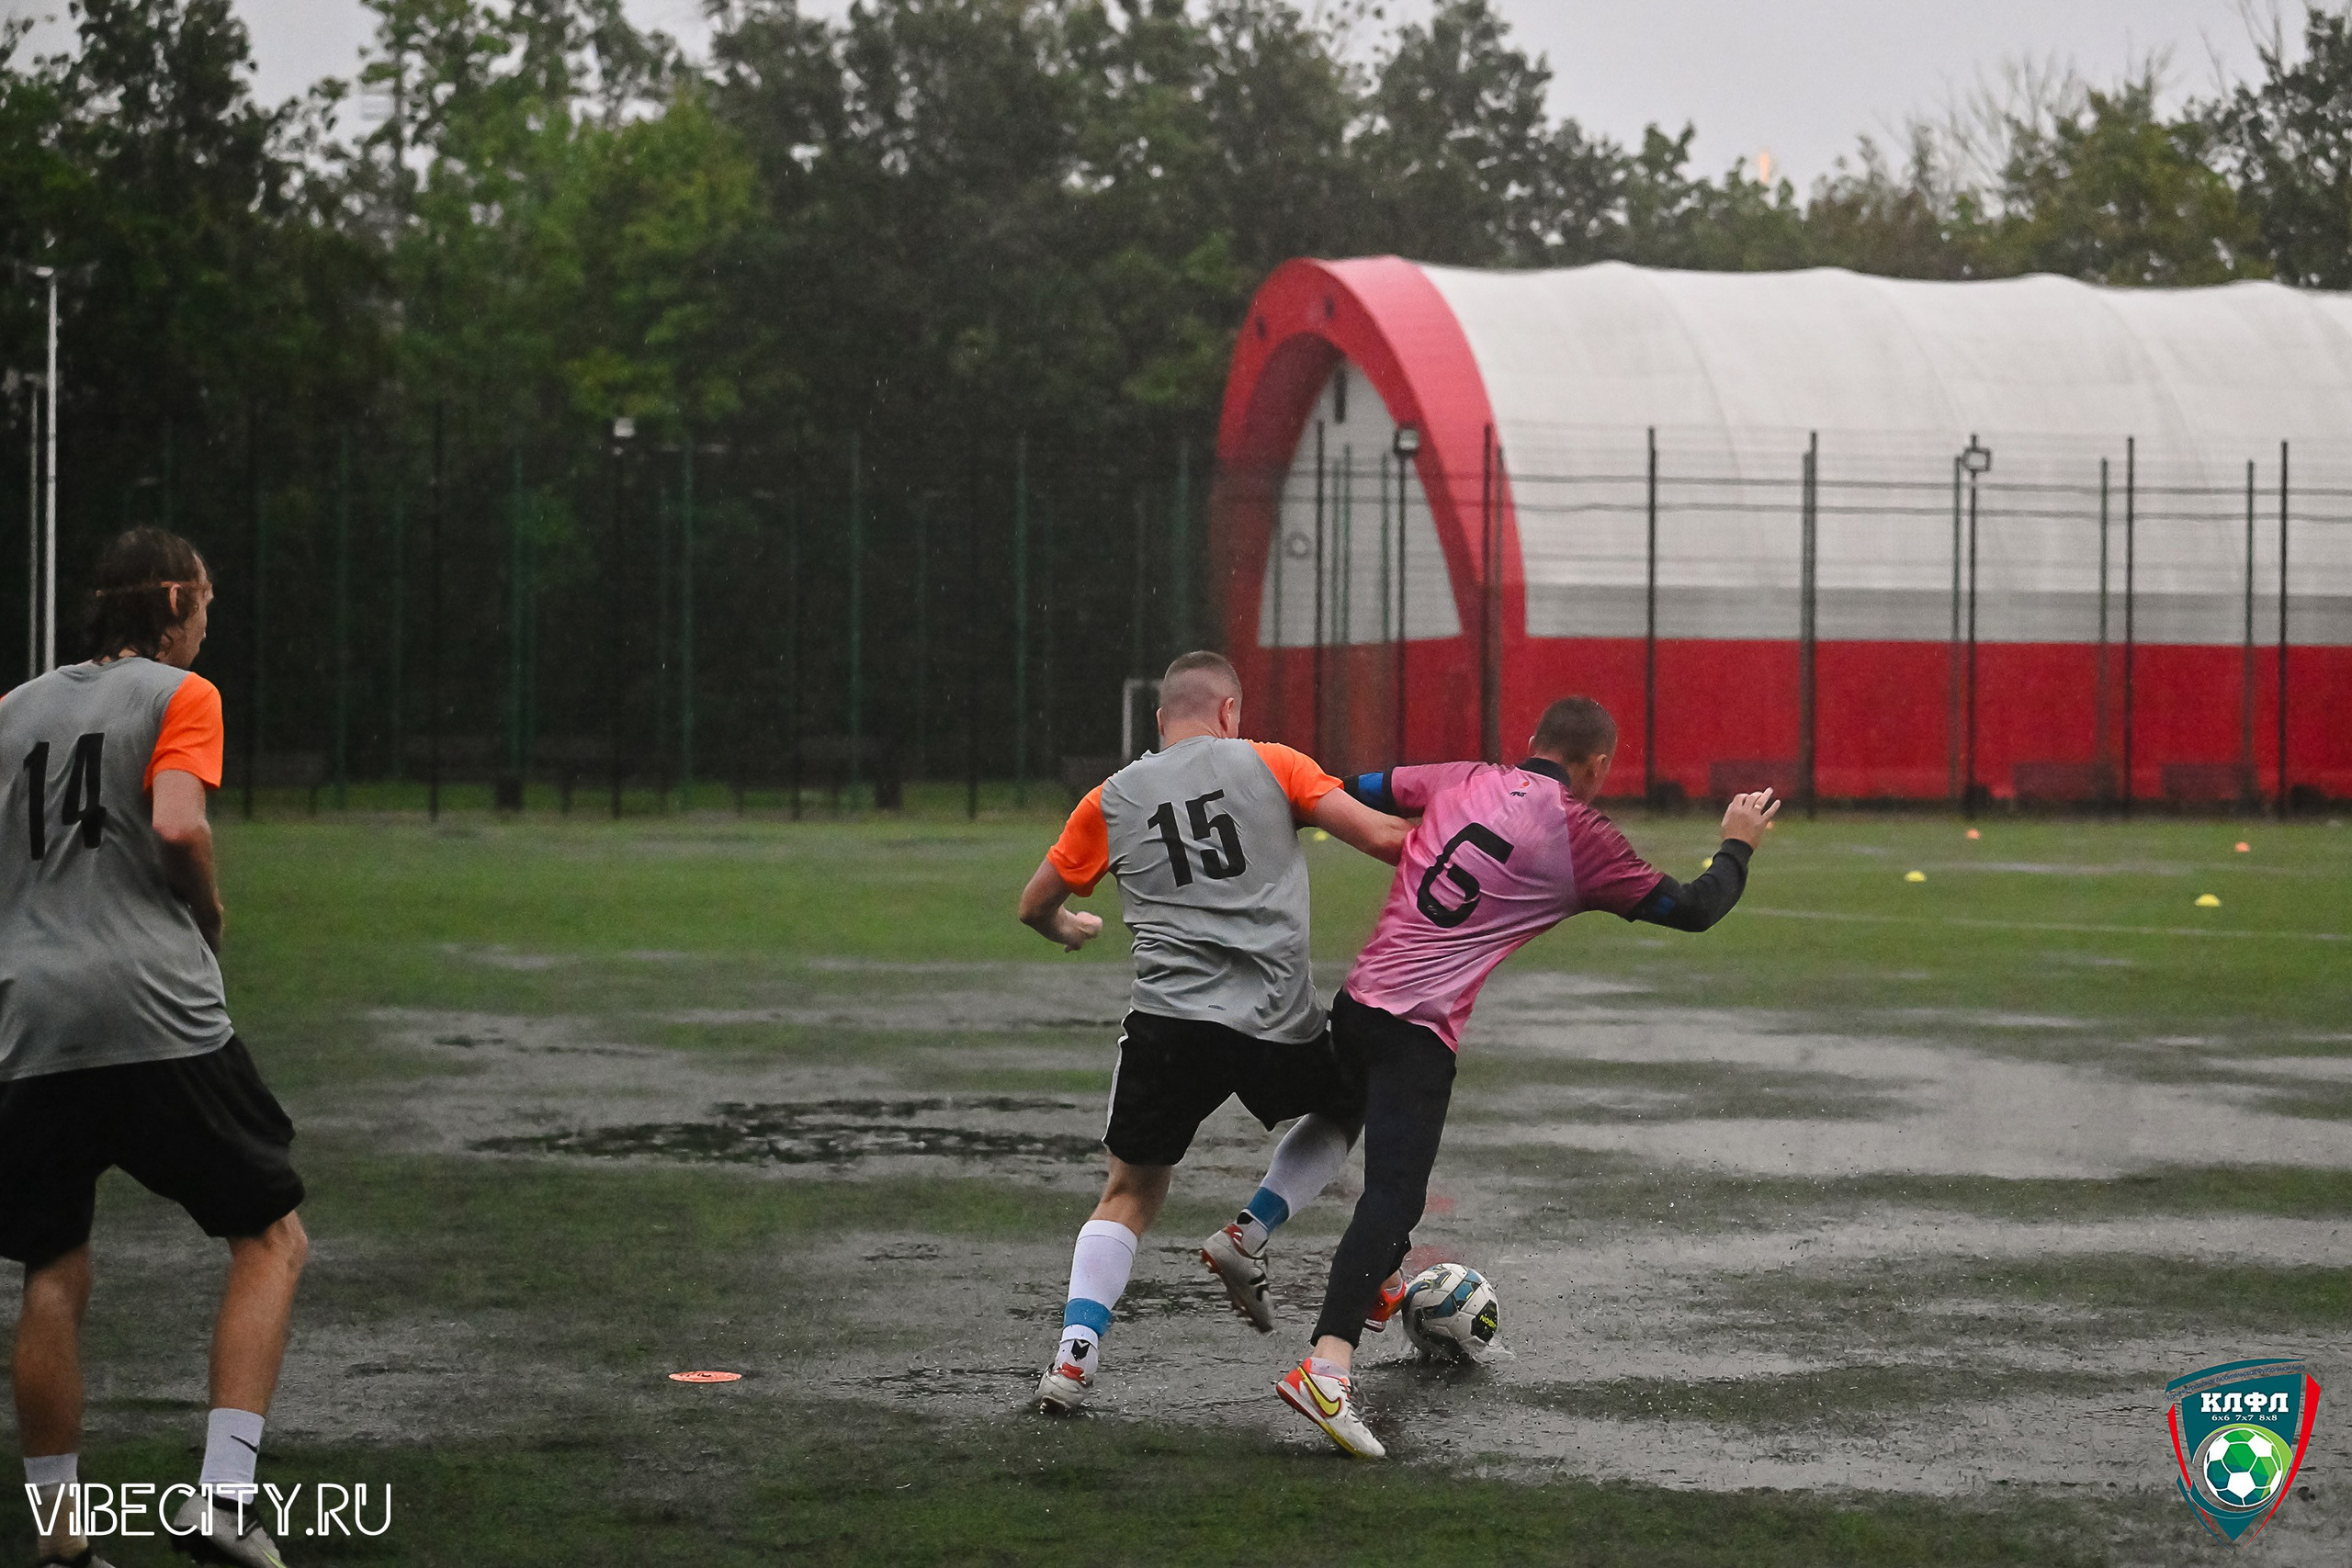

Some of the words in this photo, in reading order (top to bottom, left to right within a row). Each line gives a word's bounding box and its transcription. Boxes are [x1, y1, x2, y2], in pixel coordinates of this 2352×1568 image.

[24, 732, 106, 861] 14
[1147, 788, 1247, 887] 15
[1417, 822, 1514, 929] 6
